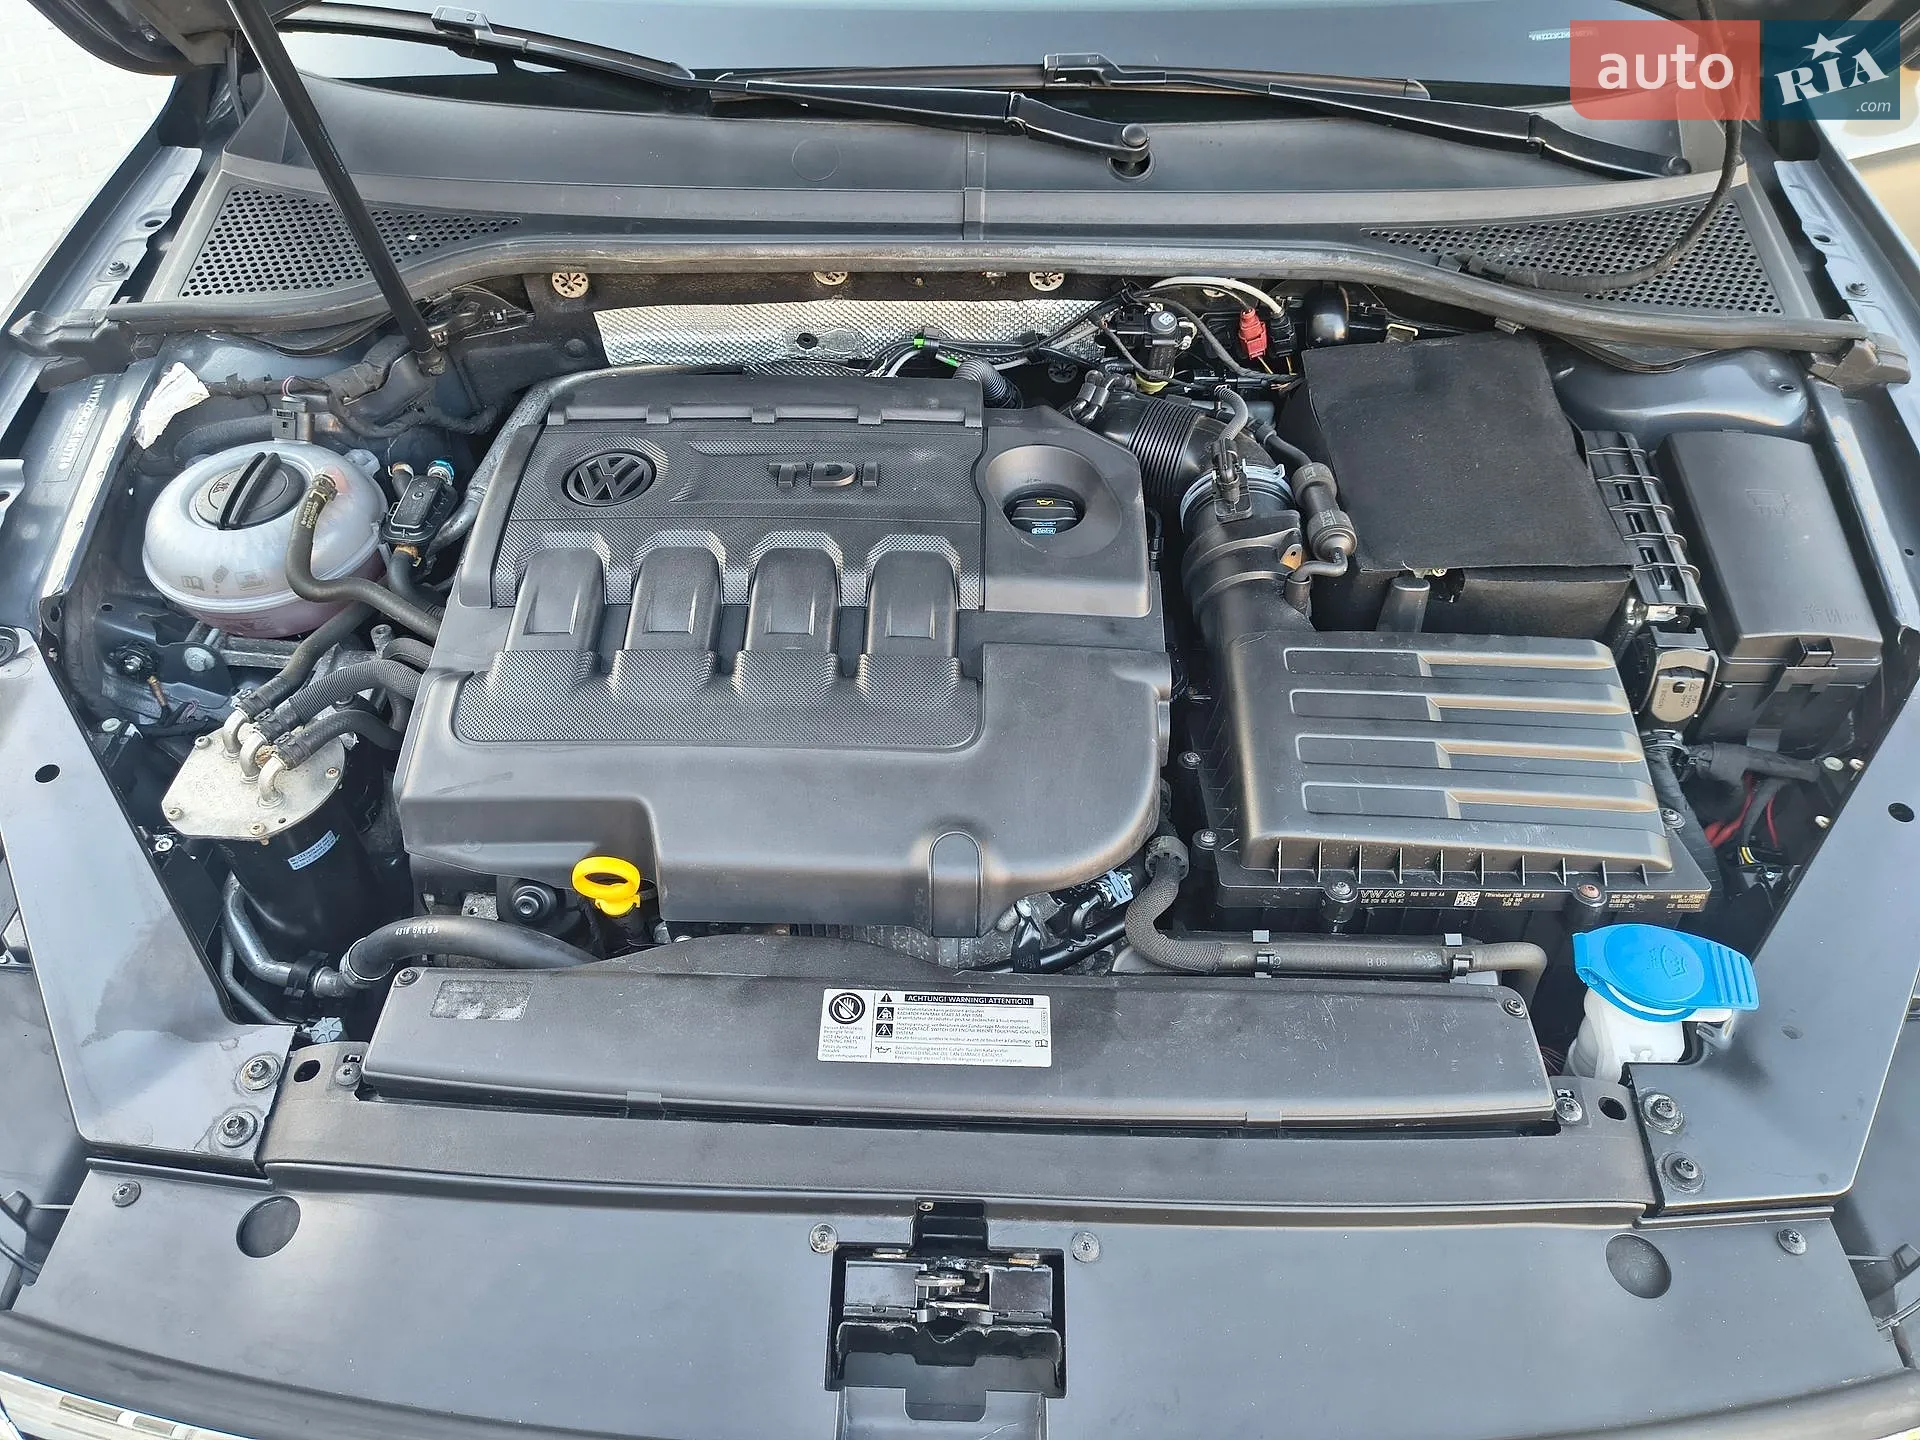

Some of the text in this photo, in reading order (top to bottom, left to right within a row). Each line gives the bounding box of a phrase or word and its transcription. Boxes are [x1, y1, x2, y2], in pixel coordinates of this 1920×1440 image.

[768, 460, 880, 488] TDI
[1360, 890, 1384, 899] VW
[1384, 890, 1406, 899] AG
[907, 994, 1031, 1005] ACHTUNG! WARNING! ATTENTION!
